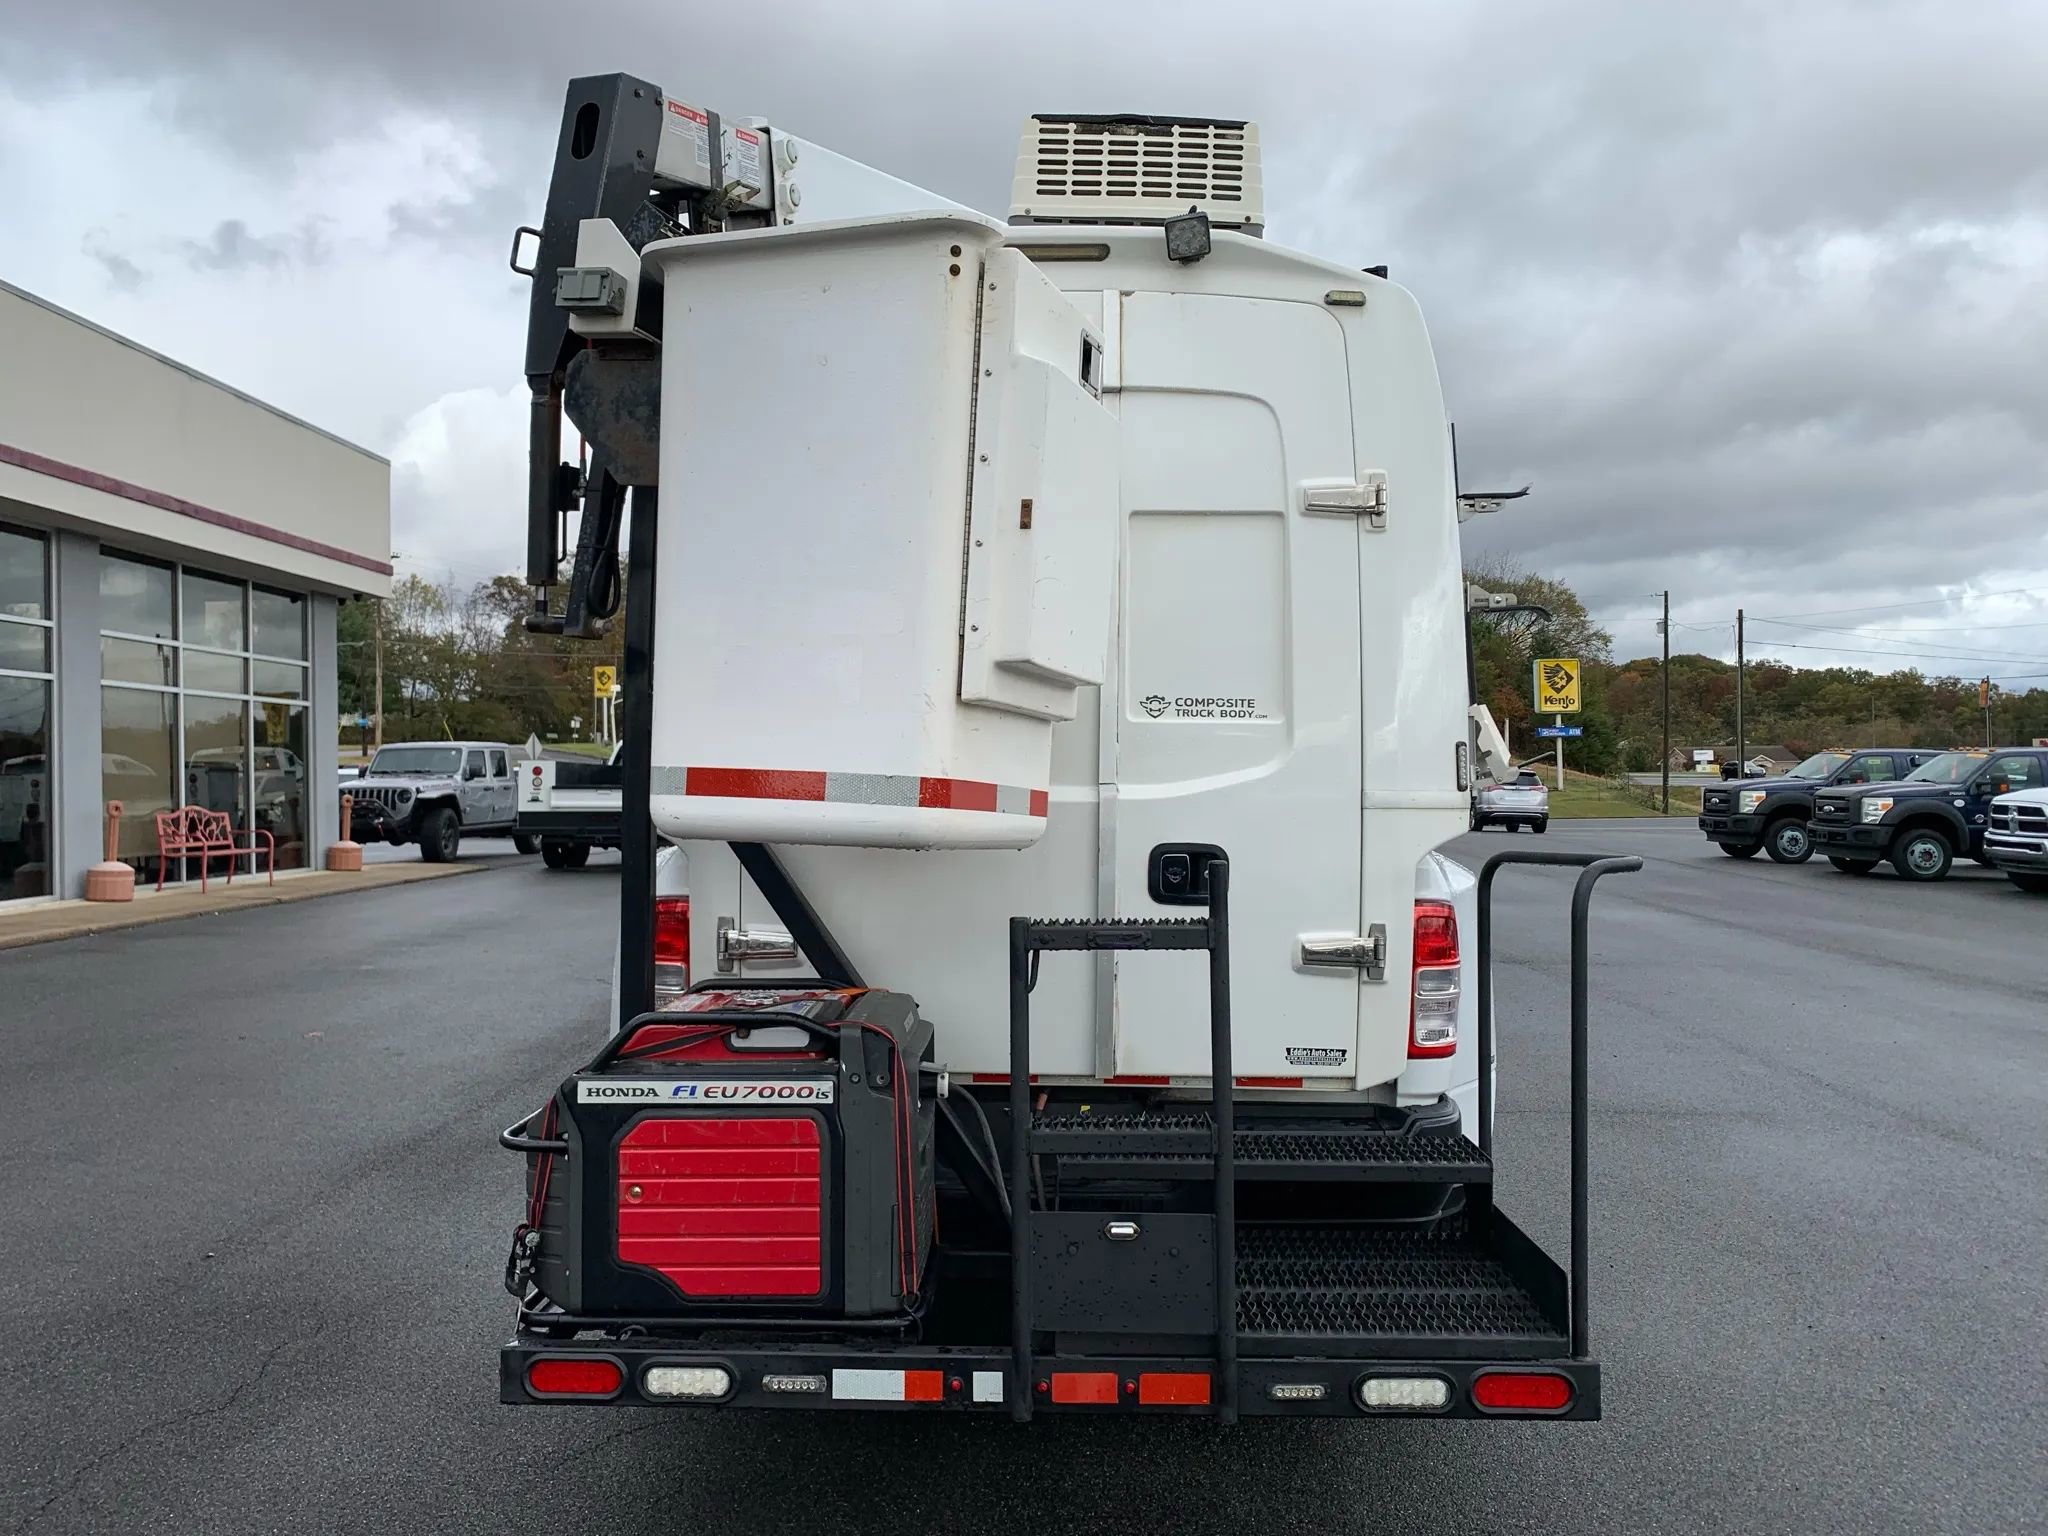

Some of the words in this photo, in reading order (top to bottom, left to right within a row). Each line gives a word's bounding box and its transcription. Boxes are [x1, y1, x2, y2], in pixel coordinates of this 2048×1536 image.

[1175, 697, 1255, 708] COMPOSITE
[1175, 708, 1215, 718] TRUCK
[1568, 728, 1581, 736] ATM
[1290, 1048, 1310, 1056] Eddie's
[1326, 1049, 1342, 1057] Sales
[586, 1087, 660, 1098] HONDA
[672, 1085, 698, 1097] FI
